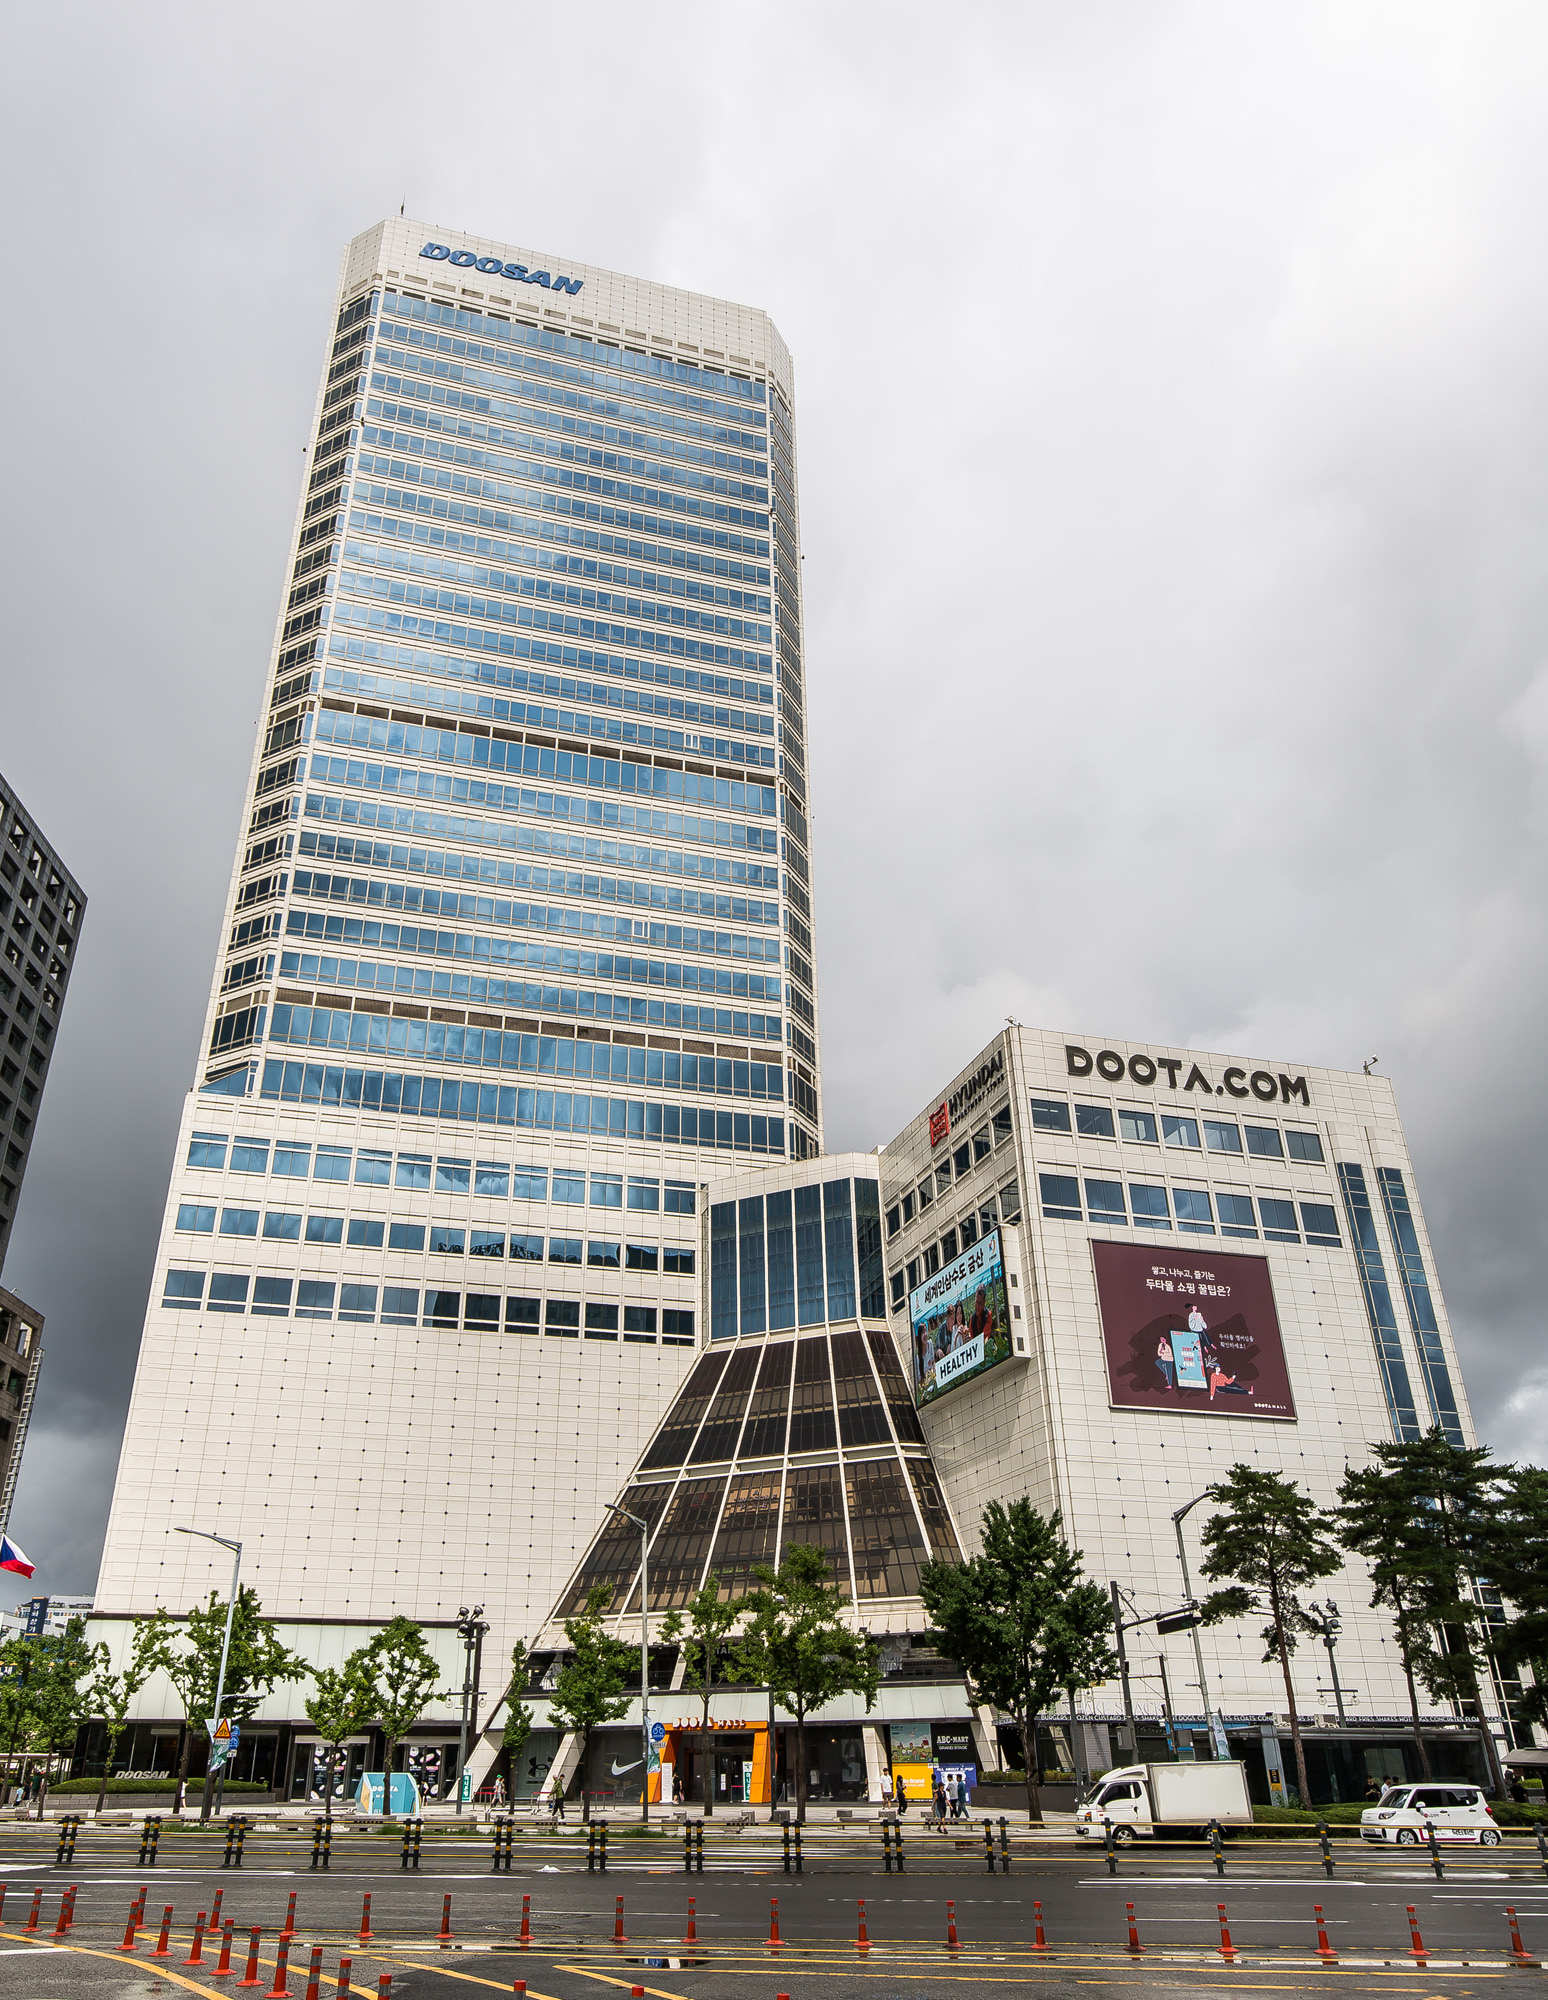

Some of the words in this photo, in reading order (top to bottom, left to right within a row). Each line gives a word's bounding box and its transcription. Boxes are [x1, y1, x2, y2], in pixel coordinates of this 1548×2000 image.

[418, 242, 584, 295] DOOSAN
[948, 1050, 1004, 1117] HYUNDAI
[1064, 1044, 1310, 1106] DOOTA.COM
[967, 1247, 985, 1275] 금산
[1169, 1267, 1193, 1279] 나누고,
[1193, 1270, 1215, 1281] 즐기는
[1145, 1278, 1175, 1292] 두타몰
[1176, 1281, 1196, 1295] 쇼핑
[1197, 1283, 1232, 1297] 꿀팁은?
[939, 1342, 979, 1380] HEALTHY
[1115, 1701, 1164, 1716] SACK
[717, 1719, 746, 1728] MALL
[114, 1771, 170, 1780] DOOSAN
